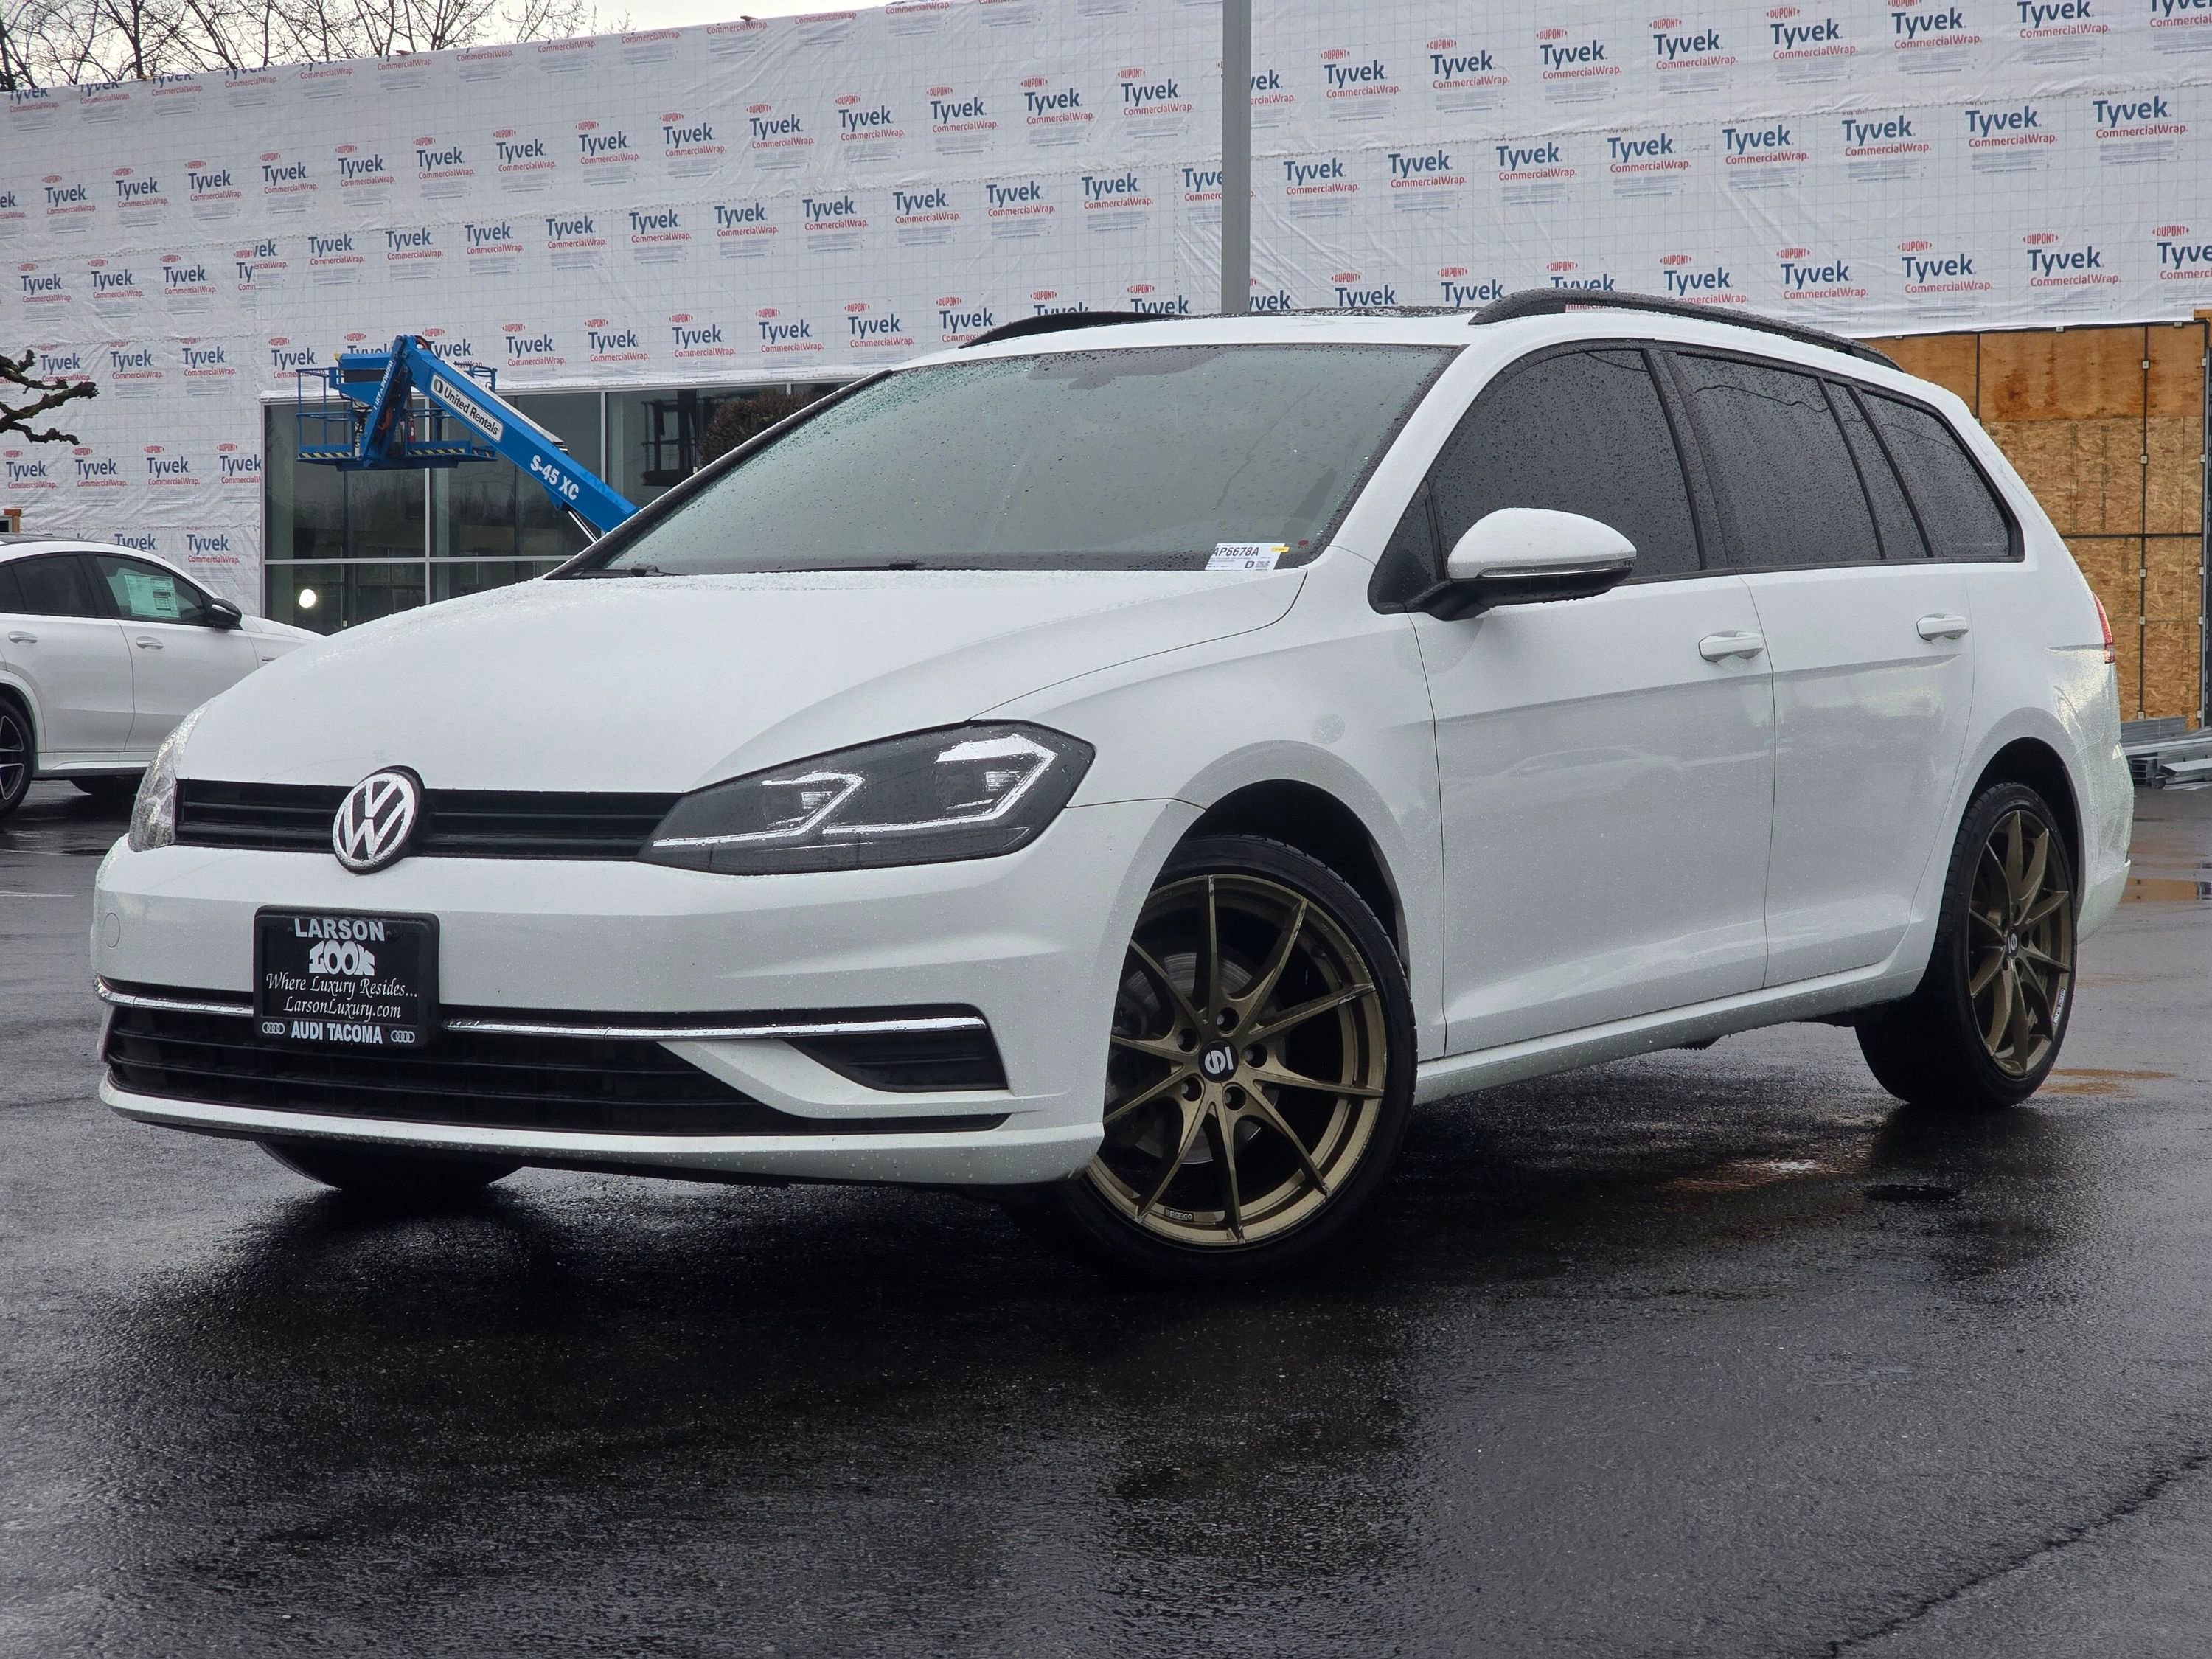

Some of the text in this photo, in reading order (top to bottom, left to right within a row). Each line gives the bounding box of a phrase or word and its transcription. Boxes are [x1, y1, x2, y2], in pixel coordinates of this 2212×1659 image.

[1892, 7, 1963, 39] Tyvek
[2017, 0, 2090, 28] Tyvek
[1653, 29, 1719, 60] Tyvek
[1770, 18, 1839, 49] Tyvek
[1430, 50, 1492, 80] Tyvek
[1540, 40, 1604, 70] Tyvek
[1324, 60, 1384, 88] Tyvek
[1024, 88, 1079, 116] Tyvek
[1121, 79, 1178, 106] Tyvek
[839, 105, 891, 132] Tyvek
[931, 97, 984, 124] Tyvek
[1966, 106, 2037, 137] Tyvek
[2093, 96, 2168, 128] Tyvek
[664, 123, 712, 148] Tyvek
[750, 114, 800, 140] Tyvek
[1842, 115, 1912, 146] Tyvek
[496, 139, 543, 164] Tyvek
[579, 131, 627, 156] Tyvek
[1607, 133, 1672, 163] Tyvek
[1722, 125, 1790, 155] Tyvek
[338, 154, 383, 178] Tyvek
[417, 147, 462, 171] Tyvek
[1388, 150, 1450, 178] Tyvek
[1496, 142, 1559, 171] Tyvek
[188, 170, 231, 192] Tyvek
[262, 162, 306, 185] Tyvek
[1284, 158, 1343, 186] Tyvek
[45, 184, 86, 207] Tyvek
[116, 177, 158, 200] Tyvek
[986, 181, 1040, 207] Tyvek
[1082, 173, 1138, 200] Tyvek
[803, 196, 854, 221] Tyvek
[893, 189, 946, 215] Tyvek
[546, 216, 593, 240] Tyvek
[629, 209, 678, 234] Tyvek
[714, 203, 765, 228] Tyvek
[308, 234, 352, 257] Tyvek
[386, 228, 431, 251] Tyvek
[465, 222, 510, 246] Tyvek
[1902, 254, 1972, 283] Tyvek
[2028, 246, 2101, 276] Tyvek
[21, 274, 61, 295] Tyvek
[91, 269, 132, 291] Tyvek
[163, 265, 205, 287] Tyvek
[1664, 267, 1730, 296] Tyvek
[1781, 260, 1848, 290] Tyvek
[1441, 280, 1502, 307] Tyvek
[759, 319, 810, 344] Tyvek
[848, 314, 900, 339] Tyvek
[939, 307, 993, 333] Tyvek
[506, 334, 552, 358] Tyvek
[588, 330, 636, 353] Tyvek
[672, 324, 722, 349] Tyvek
[40, 353, 80, 375] Tyvek
[111, 349, 151, 372] Tyvek
[183, 347, 224, 369] Tyvek
[271, 348, 315, 370] Tyvek
[443, 386, 499, 436] United Rentals
[6, 461, 46, 481] Tyvek
[75, 459, 116, 479] Tyvek
[147, 456, 188, 478] Tyvek
[529, 454, 580, 501] S-45 XC
[187, 535, 228, 554] Tyvek
[294, 918, 386, 942] LARSON
[266, 971, 307, 991] Where
[310, 975, 356, 1000] Luxury
[283, 996, 402, 1023] LarsonLuxury.com
[291, 1021, 383, 1044] AUDI TACOMA
